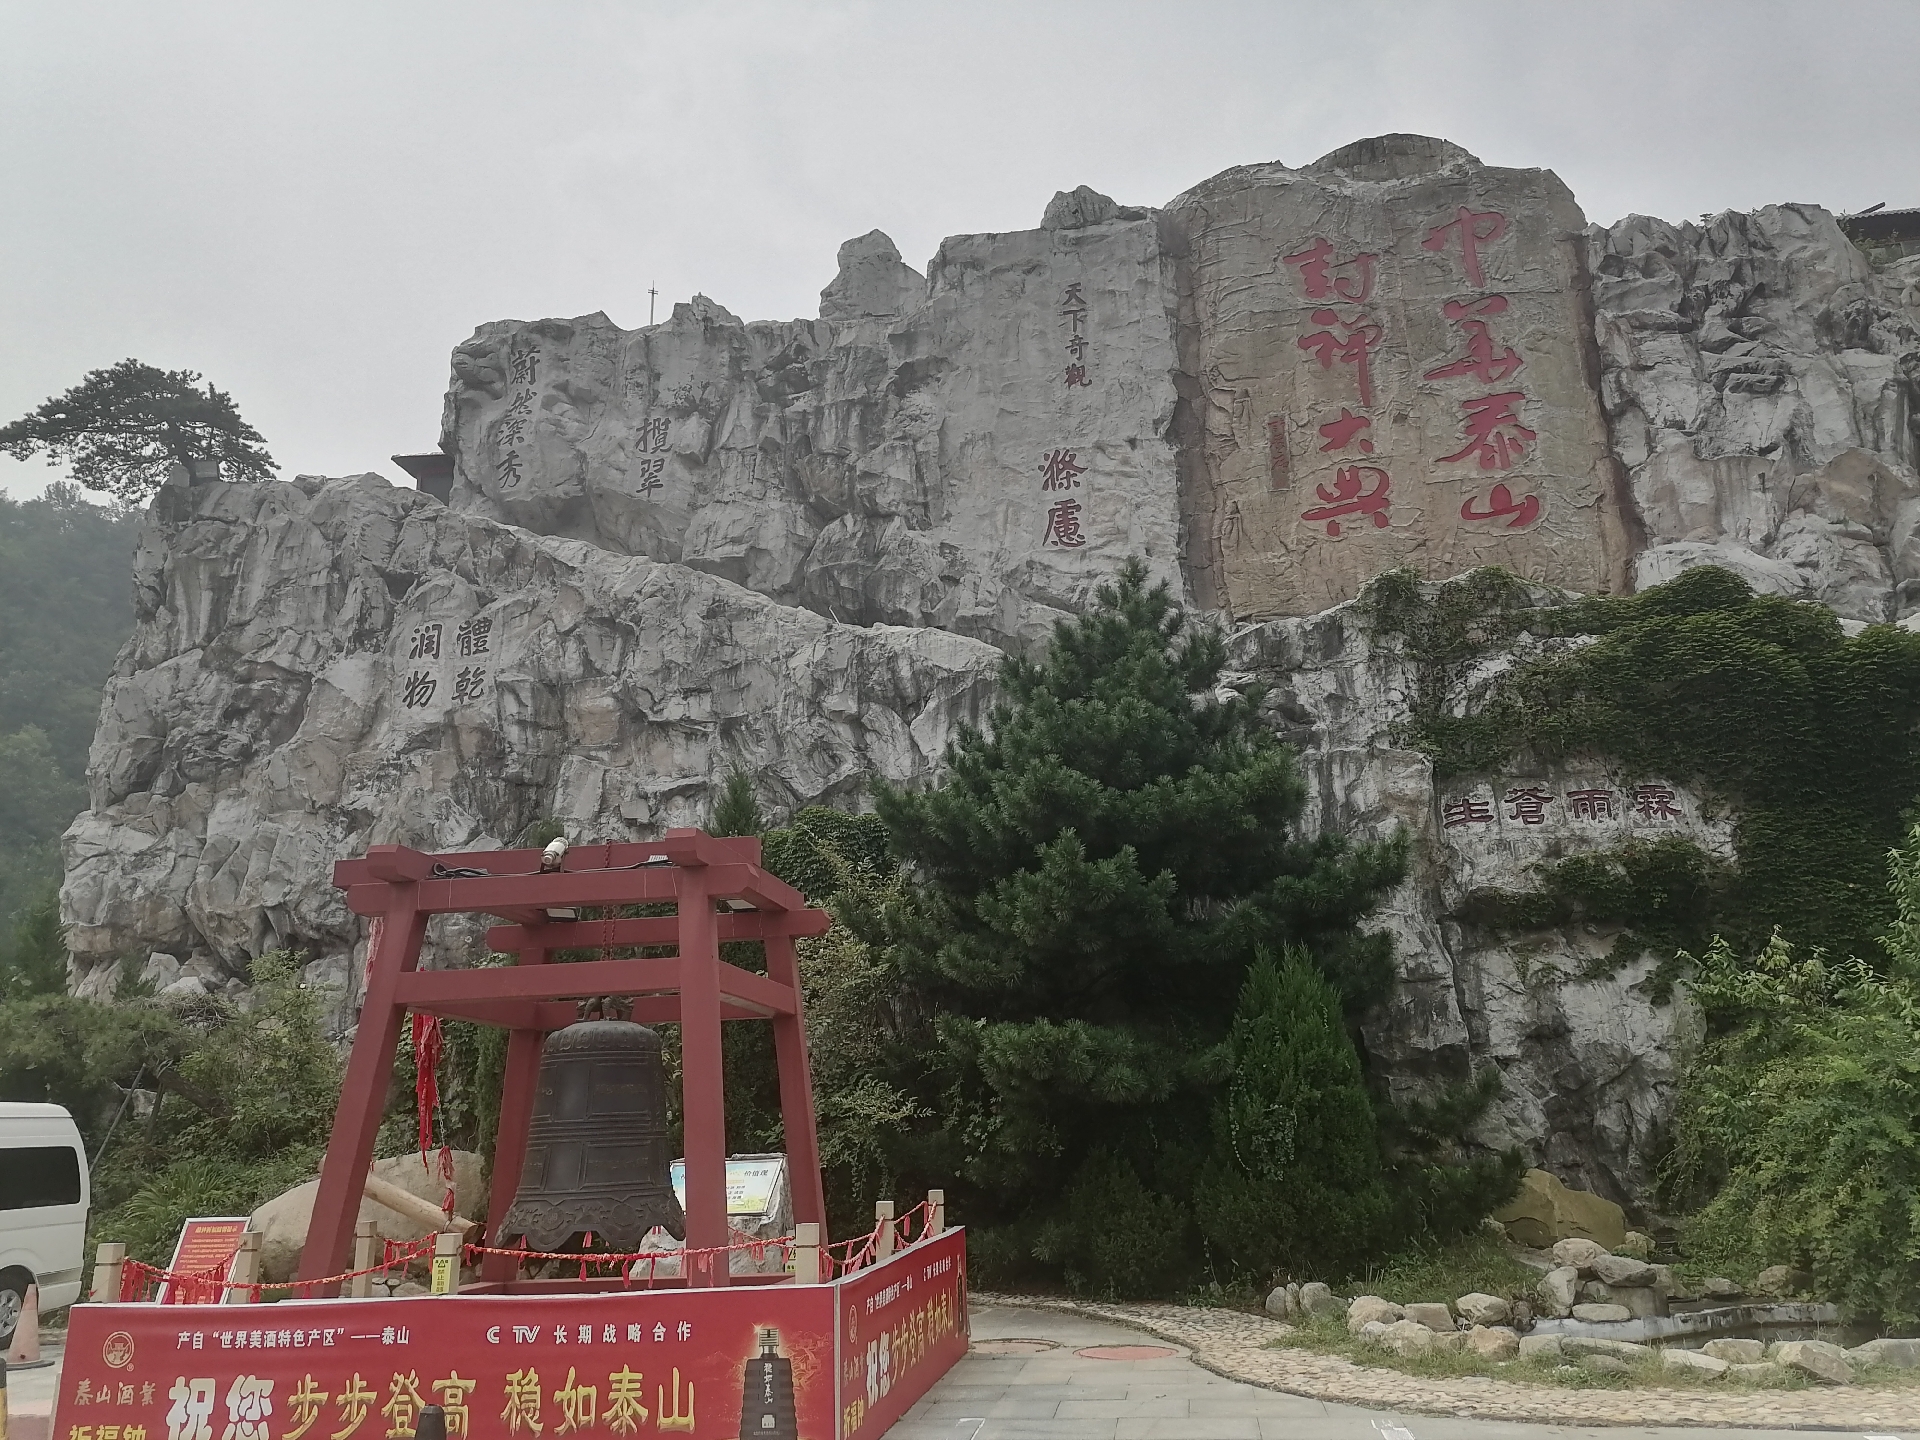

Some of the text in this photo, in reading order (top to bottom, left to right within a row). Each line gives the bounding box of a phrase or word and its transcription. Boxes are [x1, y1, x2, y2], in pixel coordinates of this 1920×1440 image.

[553, 1321, 692, 1345] 长期战略合作
